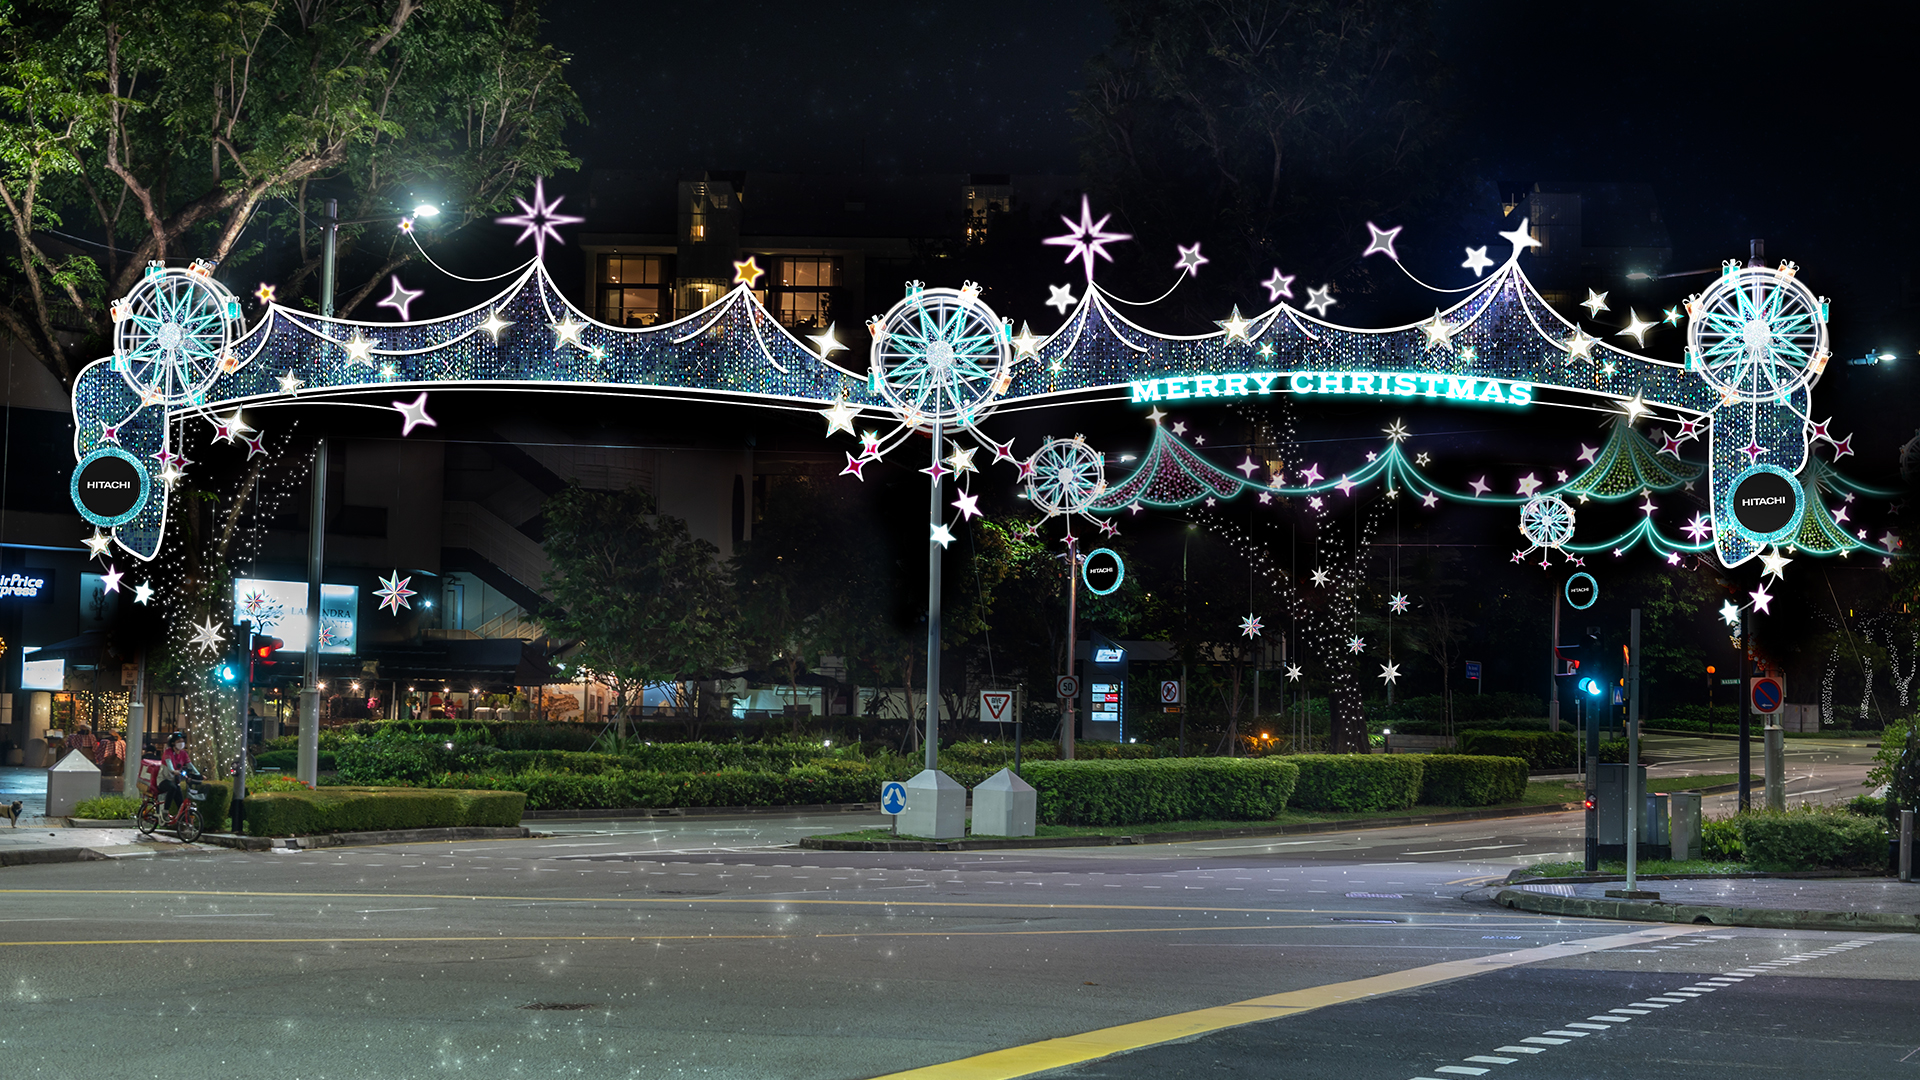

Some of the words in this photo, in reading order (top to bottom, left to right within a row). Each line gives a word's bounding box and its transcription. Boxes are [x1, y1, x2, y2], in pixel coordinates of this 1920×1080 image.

[1130, 372, 1278, 403] MERRY
[1290, 371, 1532, 406] CHRISTMAS
[87, 481, 131, 489] HITACHI
[1742, 496, 1786, 507] HITACHI
[1063, 682, 1073, 692] 50
